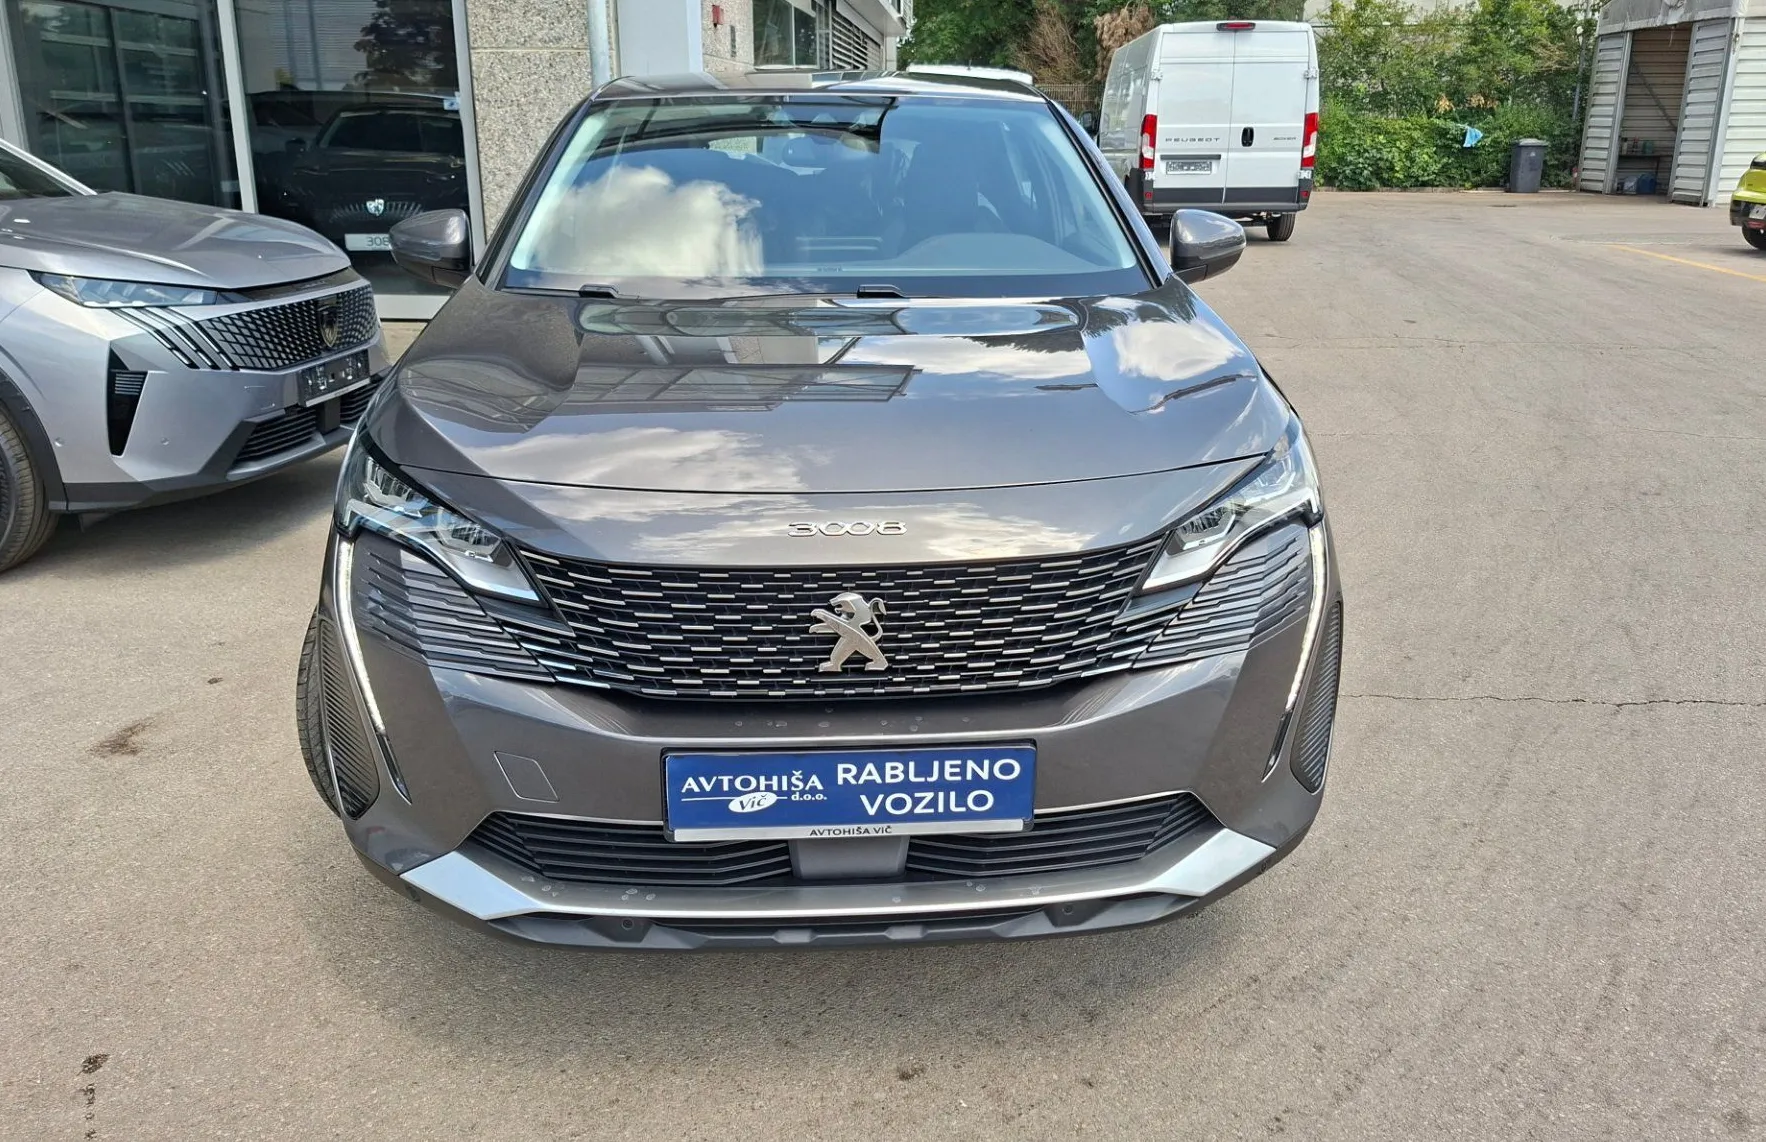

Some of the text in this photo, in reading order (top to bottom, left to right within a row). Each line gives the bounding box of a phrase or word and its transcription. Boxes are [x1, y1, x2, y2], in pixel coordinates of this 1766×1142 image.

[787, 521, 907, 537] 3008
[681, 770, 824, 793] AVTOHIŠA
[837, 758, 1021, 785] RABLJENO
[739, 792, 828, 811] Vič d.o.o.
[860, 789, 995, 816] VOZILO
[809, 825, 892, 836] AVTOHIŠA VIČ
